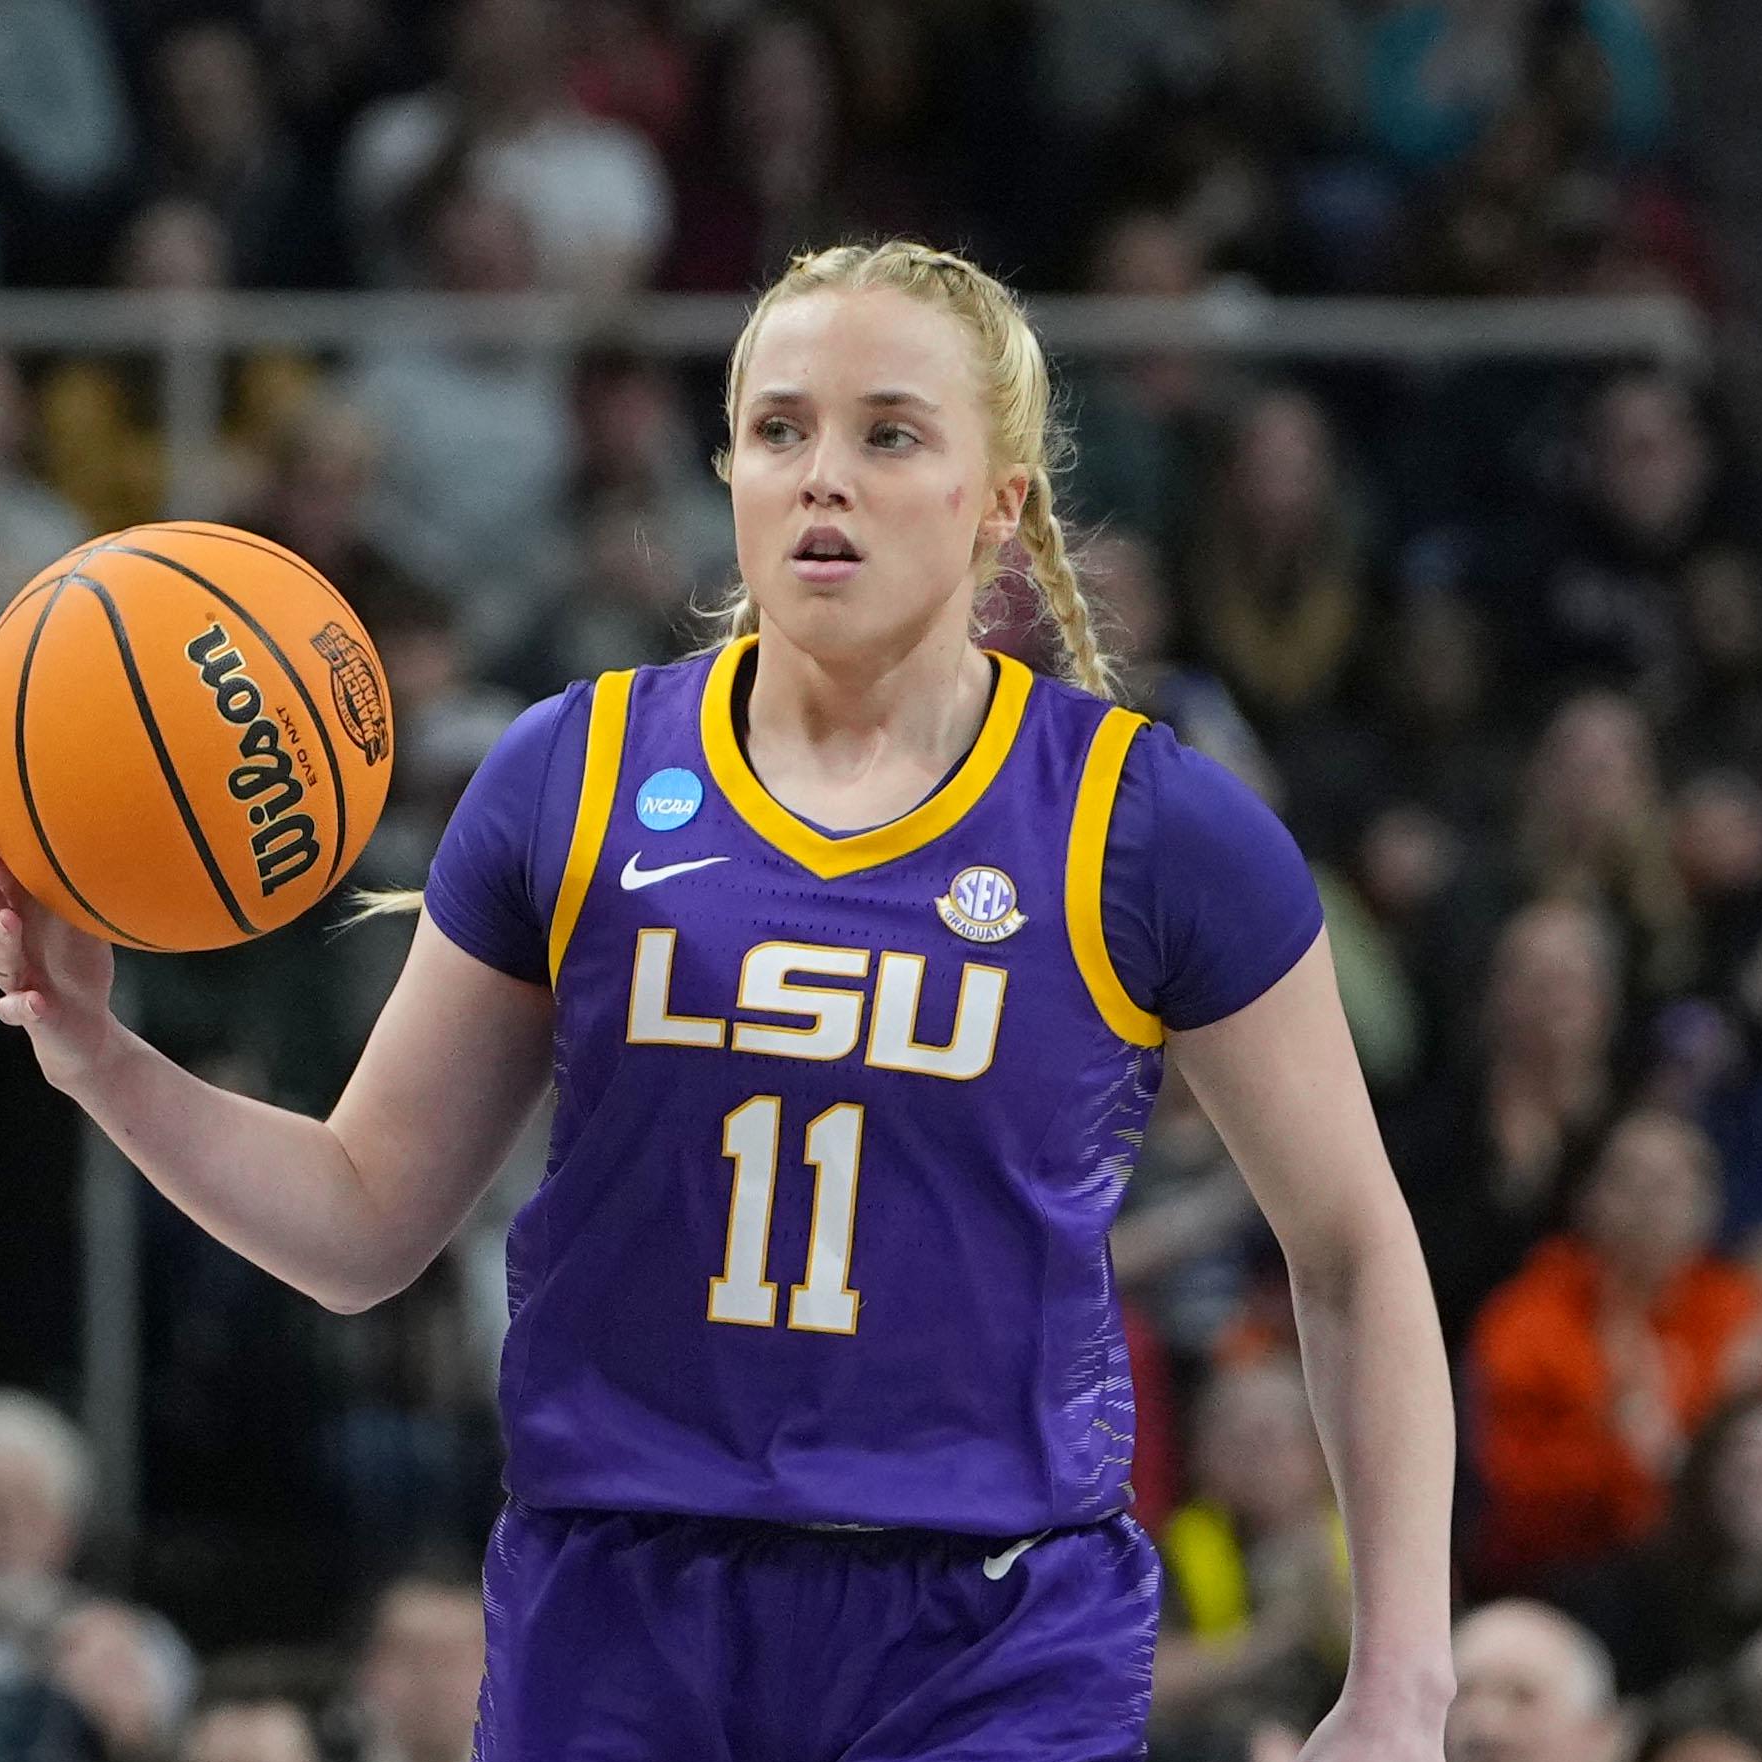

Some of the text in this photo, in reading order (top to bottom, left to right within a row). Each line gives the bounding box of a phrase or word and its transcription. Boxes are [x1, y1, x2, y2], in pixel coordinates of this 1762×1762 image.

[339, 664, 379, 742] MARCH
[185, 621, 320, 897] Wilson
[276, 706, 317, 787] EVO NXT
[641, 796, 695, 815] NCAA
[944, 909, 1011, 940] GRADUATE
[956, 870, 1011, 921] SEC
[626, 927, 1009, 1082] LSU
[706, 1094, 865, 1336] 11
